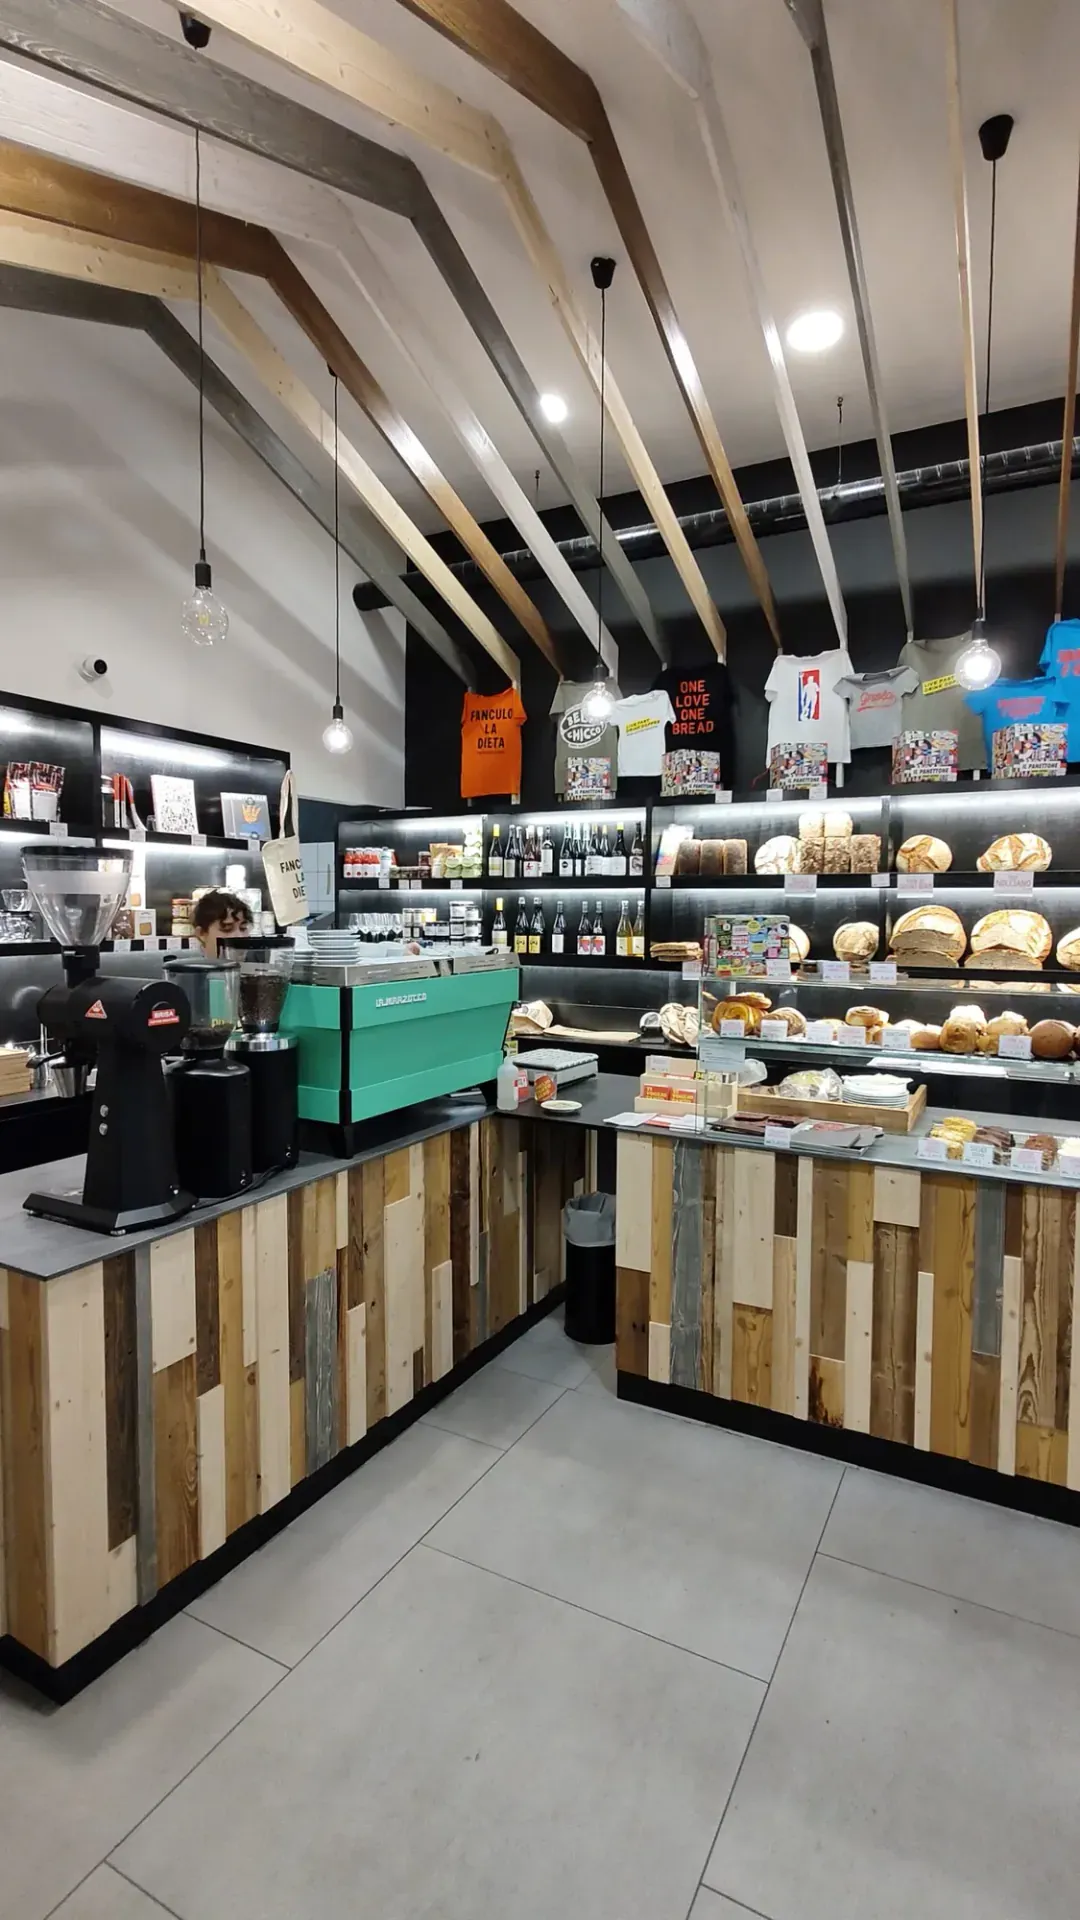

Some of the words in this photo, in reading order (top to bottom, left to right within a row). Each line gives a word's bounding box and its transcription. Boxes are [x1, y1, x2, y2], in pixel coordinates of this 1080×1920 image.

[680, 679, 706, 693] ONE
[675, 693, 710, 708] LOVE
[470, 708, 513, 722] FANCULO
[567, 708, 590, 727] BEL
[680, 708, 706, 721] ONE
[484, 723, 497, 735] LA
[672, 720, 714, 735] BREAD
[477, 737, 505, 749] DIETA
[280, 858, 303, 873] FANC
[292, 886, 307, 899] DIE
